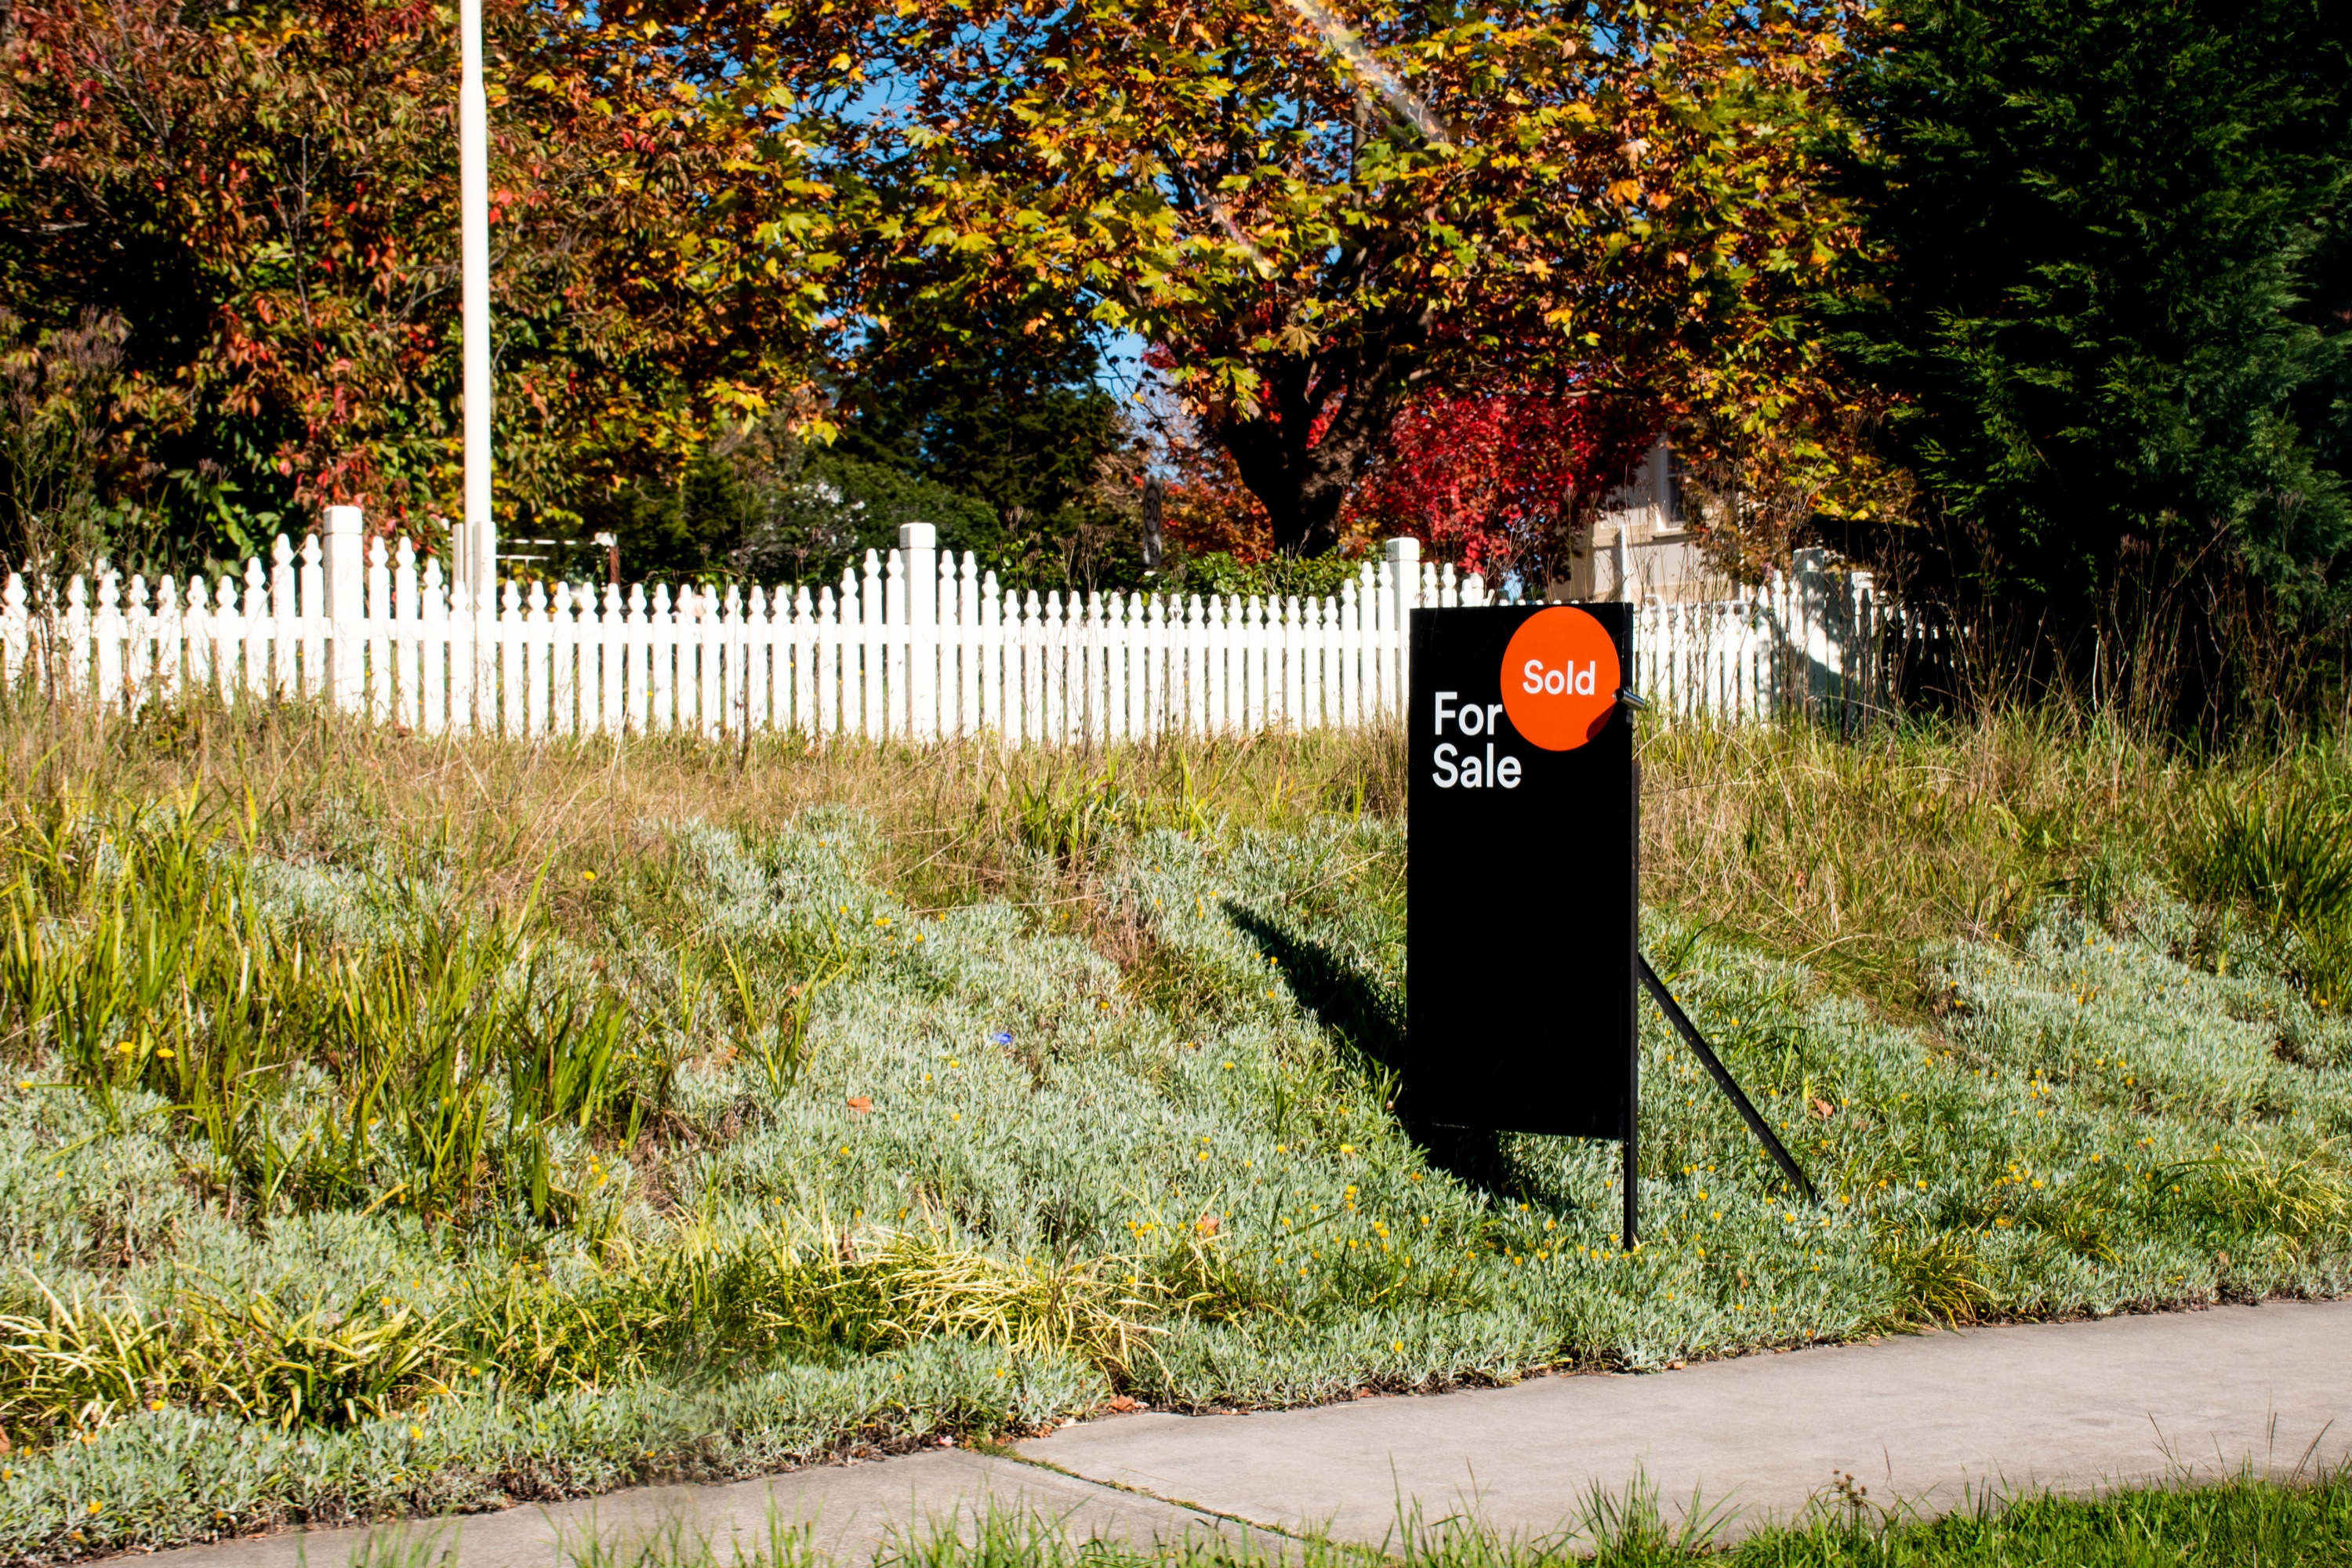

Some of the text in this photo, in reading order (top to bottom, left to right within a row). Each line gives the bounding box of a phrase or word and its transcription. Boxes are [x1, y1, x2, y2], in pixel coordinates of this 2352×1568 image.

[1146, 497, 1158, 522] 50
[1522, 659, 1596, 696] Sold
[1435, 691, 1503, 736] For
[1432, 742, 1522, 789] Sale
